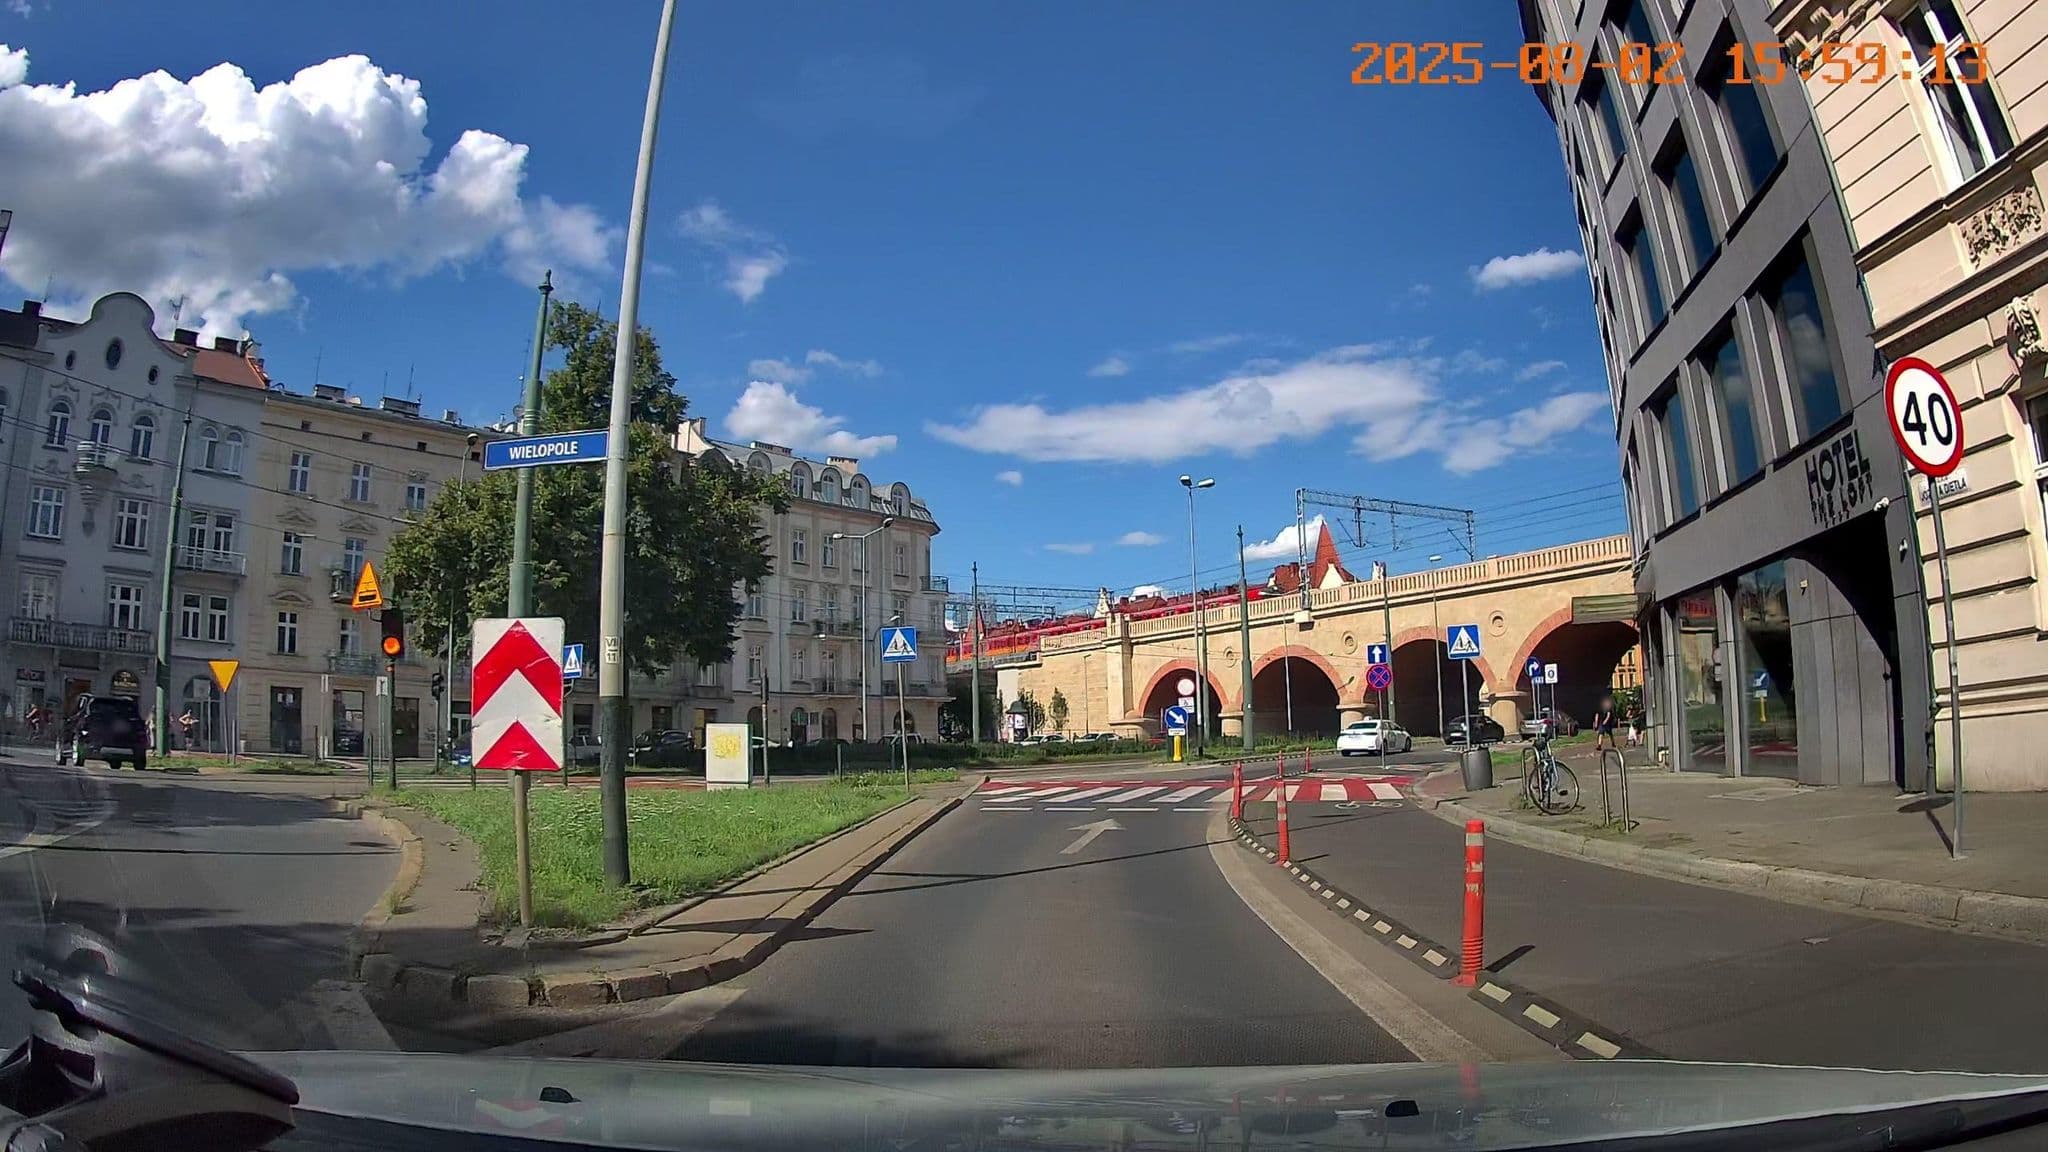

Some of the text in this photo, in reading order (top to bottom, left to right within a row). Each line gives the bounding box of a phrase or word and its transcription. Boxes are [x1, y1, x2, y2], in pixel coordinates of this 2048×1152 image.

[1903, 391, 1952, 446] 40
[509, 441, 578, 460] WIELOPOLE
[1805, 429, 1870, 501] HOTEL
